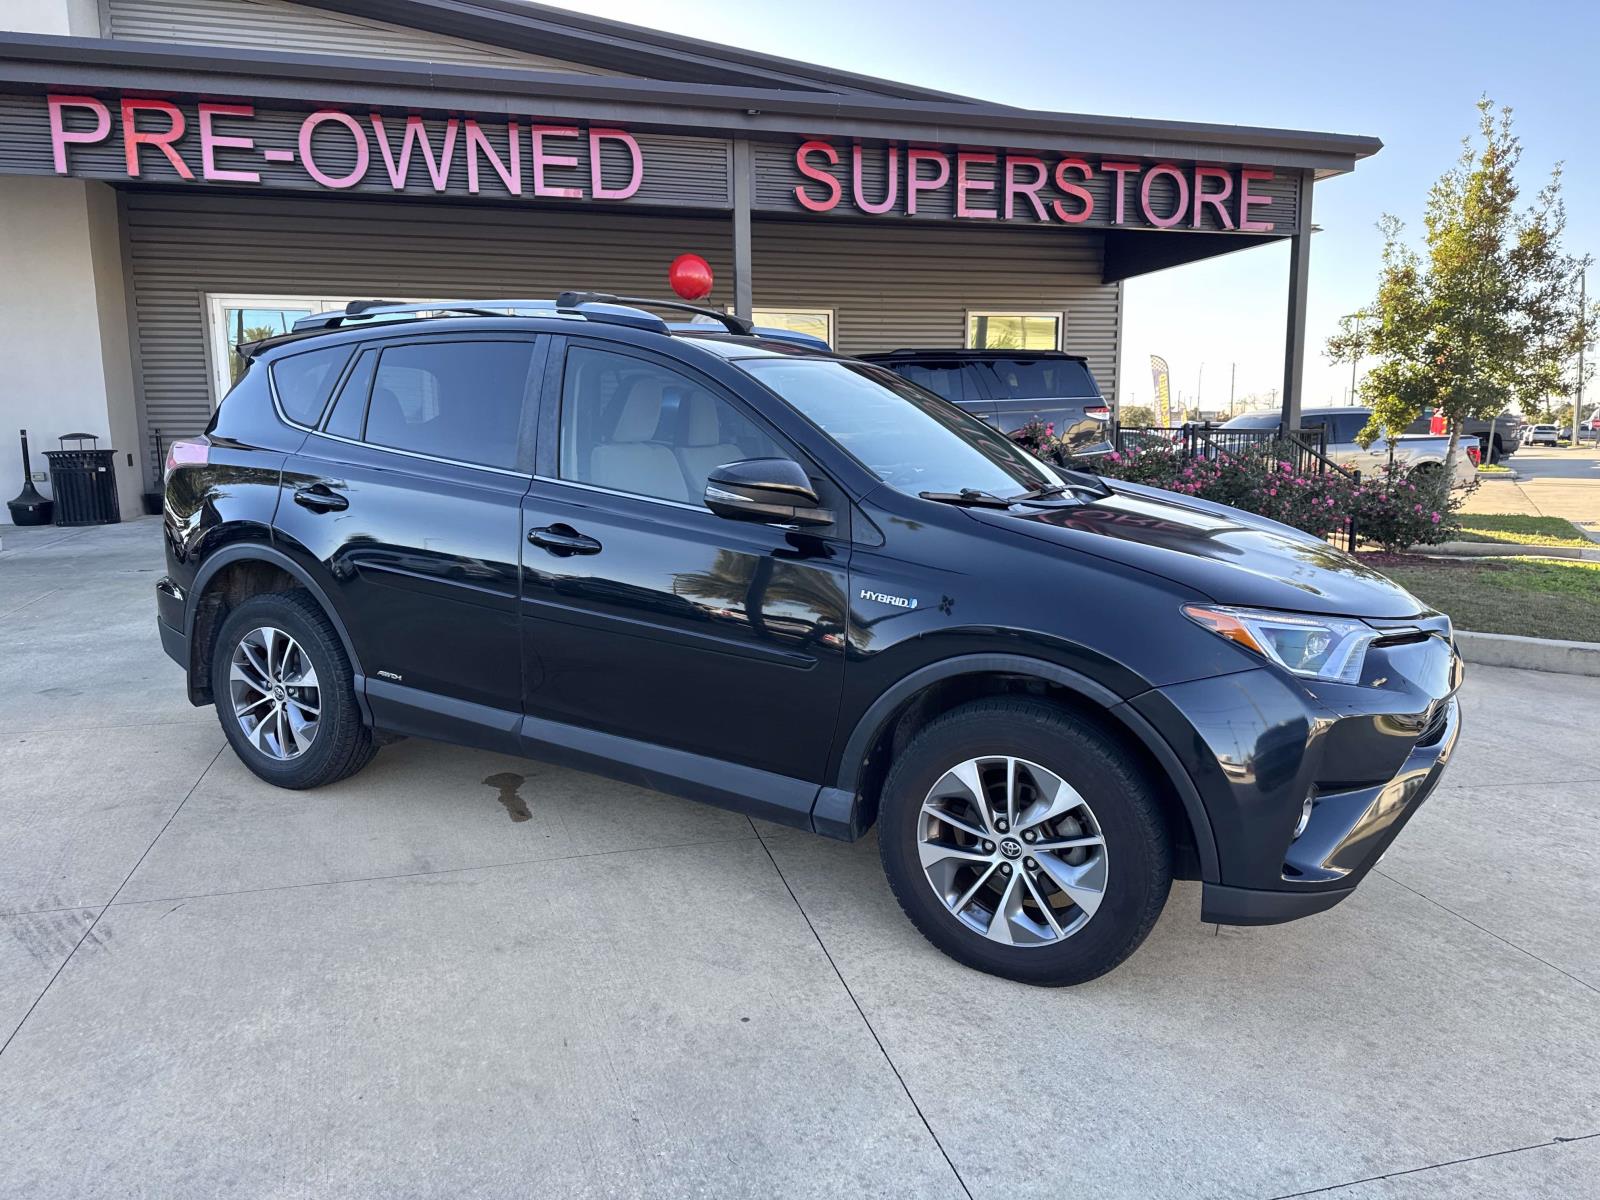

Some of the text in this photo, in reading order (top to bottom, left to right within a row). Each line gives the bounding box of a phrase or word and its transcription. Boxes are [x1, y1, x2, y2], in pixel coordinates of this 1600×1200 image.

[47, 95, 1275, 232] PRE-OWNED SUPERSTORE
[860, 589, 909, 608] HYBRID
